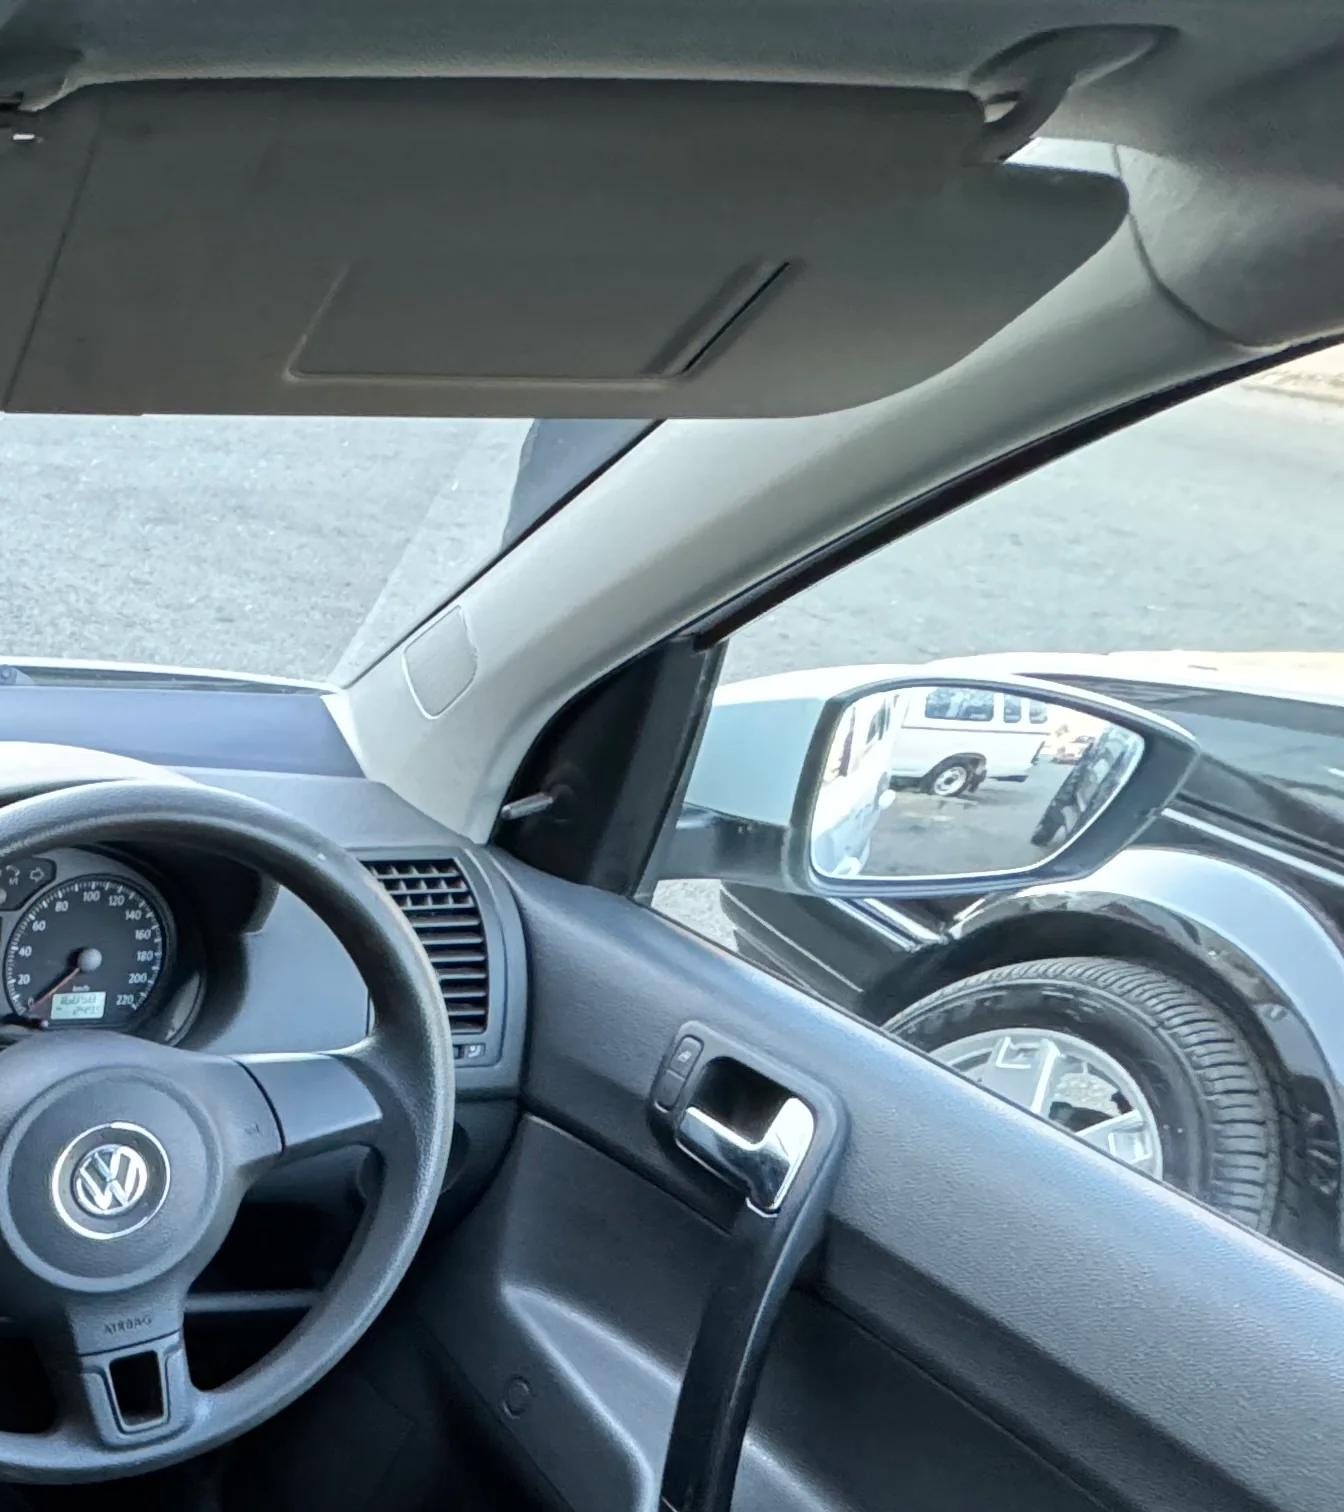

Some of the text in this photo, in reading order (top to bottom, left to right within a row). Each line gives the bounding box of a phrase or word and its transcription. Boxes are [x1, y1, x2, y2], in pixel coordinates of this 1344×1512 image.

[83, 890, 101, 902] 100
[108, 895, 125, 907] 120
[55, 901, 69, 912] 80
[125, 910, 142, 921] 140
[32, 920, 46, 932] 60
[135, 929, 152, 940] 160
[18, 946, 32, 957] 40
[136, 951, 154, 962] 180
[17, 974, 31, 985] 20
[128, 973, 147, 984] 200
[116, 994, 134, 1006] 220
[103, 1315, 153, 1335] AIRBAG
